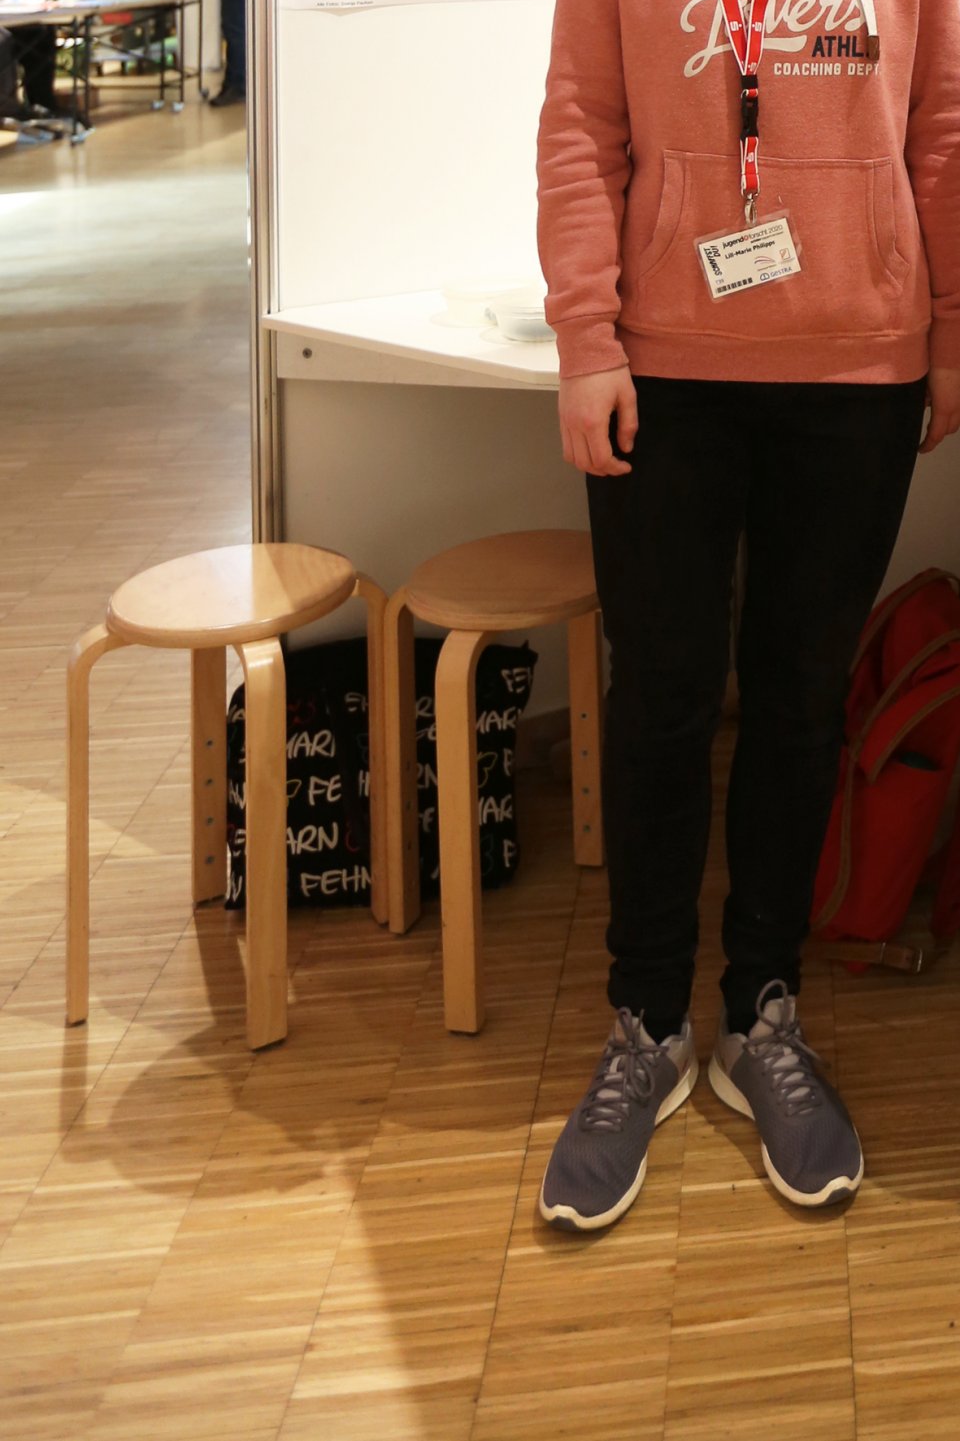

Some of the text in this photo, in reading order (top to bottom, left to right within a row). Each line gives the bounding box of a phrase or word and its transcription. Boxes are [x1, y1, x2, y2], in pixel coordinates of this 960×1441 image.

[811, 35, 869, 58] ATHL
[773, 62, 841, 76] COACHING
[722, 237, 744, 249] jugend
[768, 225, 783, 234] 2020
[286, 821, 338, 856] ARN
